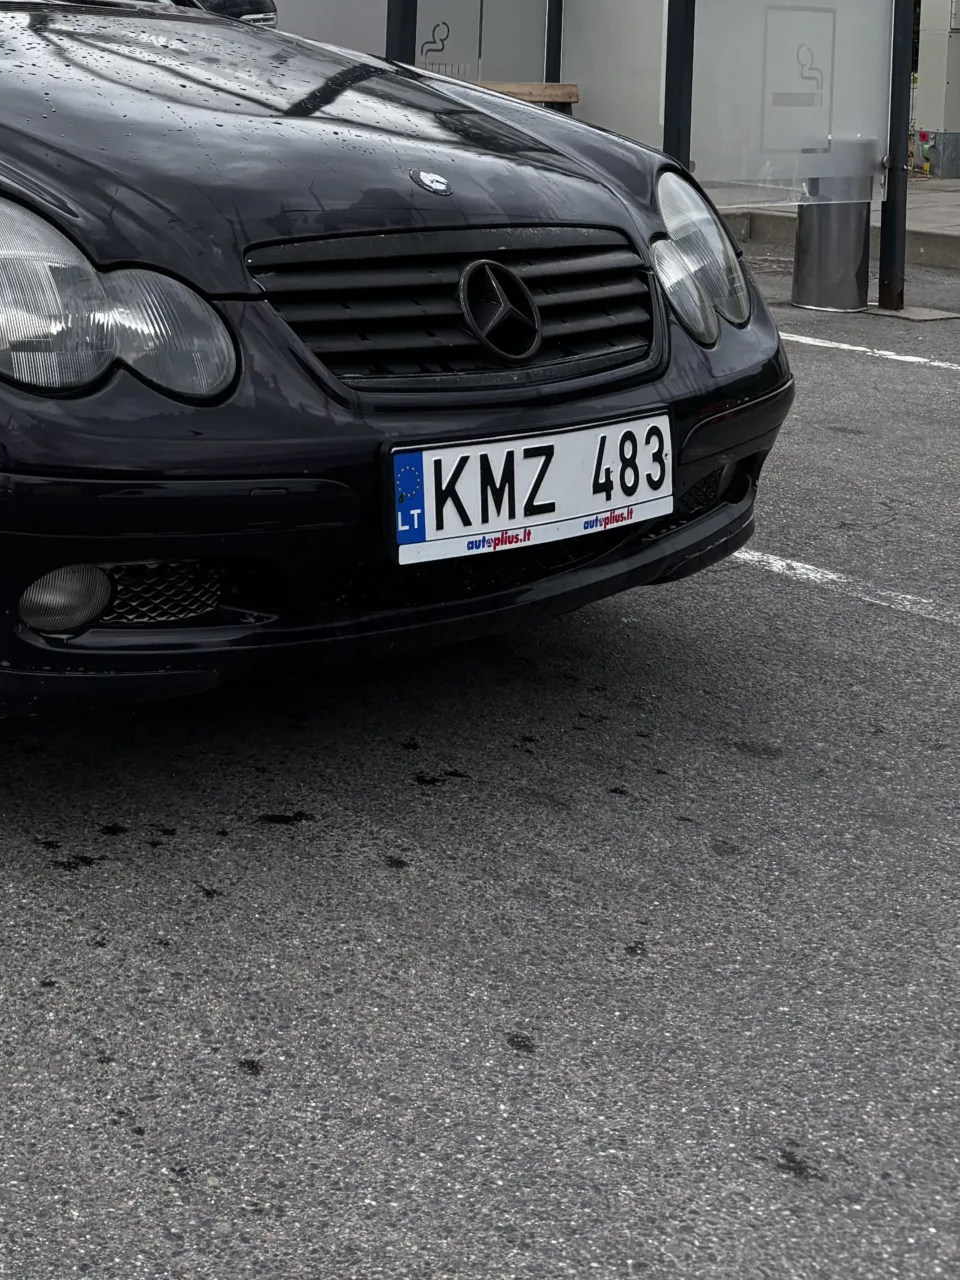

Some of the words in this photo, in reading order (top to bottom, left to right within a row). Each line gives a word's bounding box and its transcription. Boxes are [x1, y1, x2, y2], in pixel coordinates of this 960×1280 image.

[433, 444, 556, 531] KMZ
[592, 425, 666, 502] 483
[397, 508, 422, 532] LT
